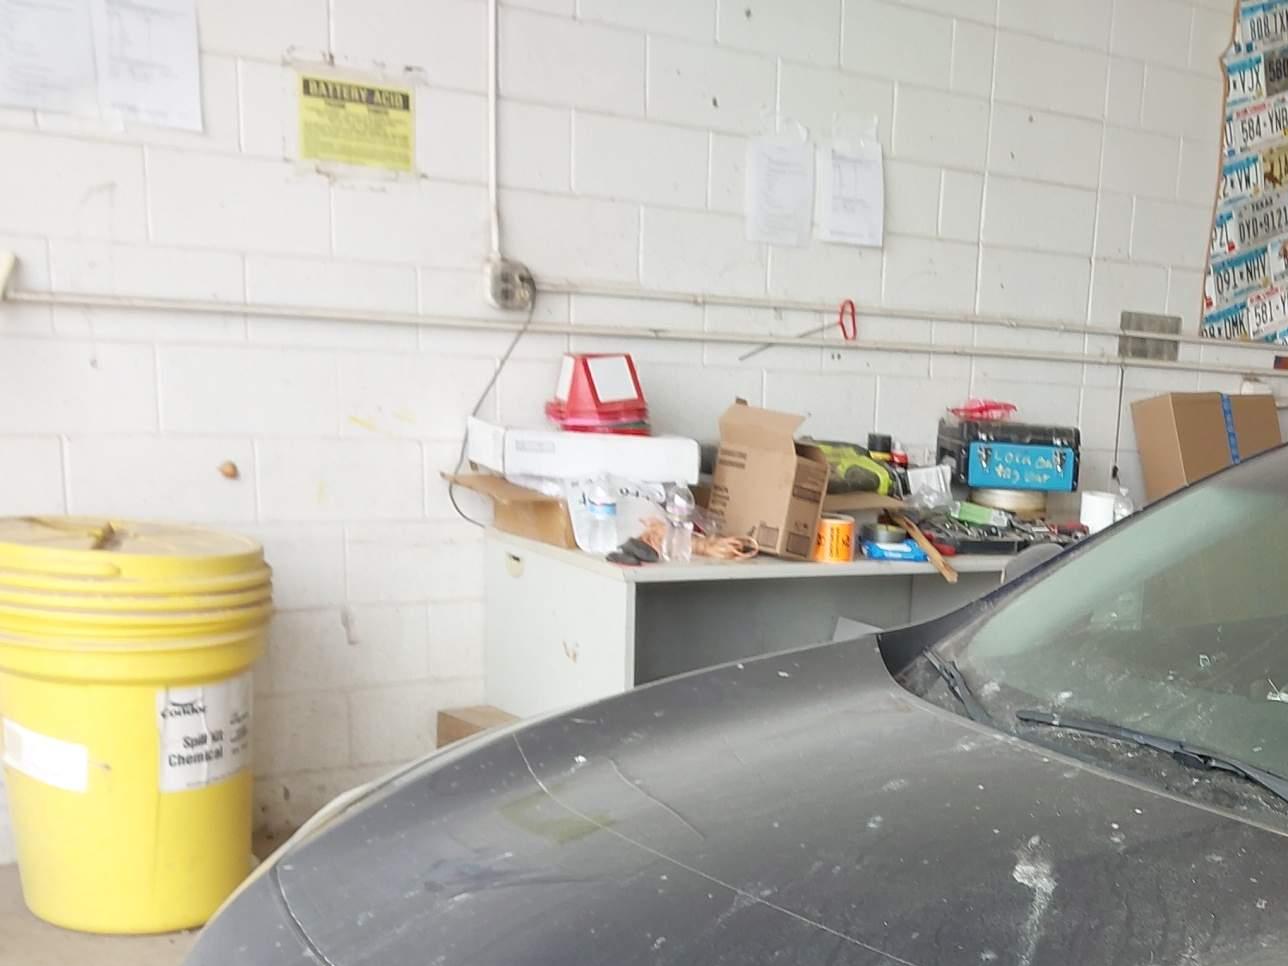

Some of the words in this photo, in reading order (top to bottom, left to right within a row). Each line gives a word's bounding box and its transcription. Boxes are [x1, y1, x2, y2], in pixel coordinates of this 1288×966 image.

[308, 79, 367, 105] BATTERY
[373, 89, 404, 110] ACID
[183, 733, 207, 749] Spill
[168, 744, 224, 768] Chemical
